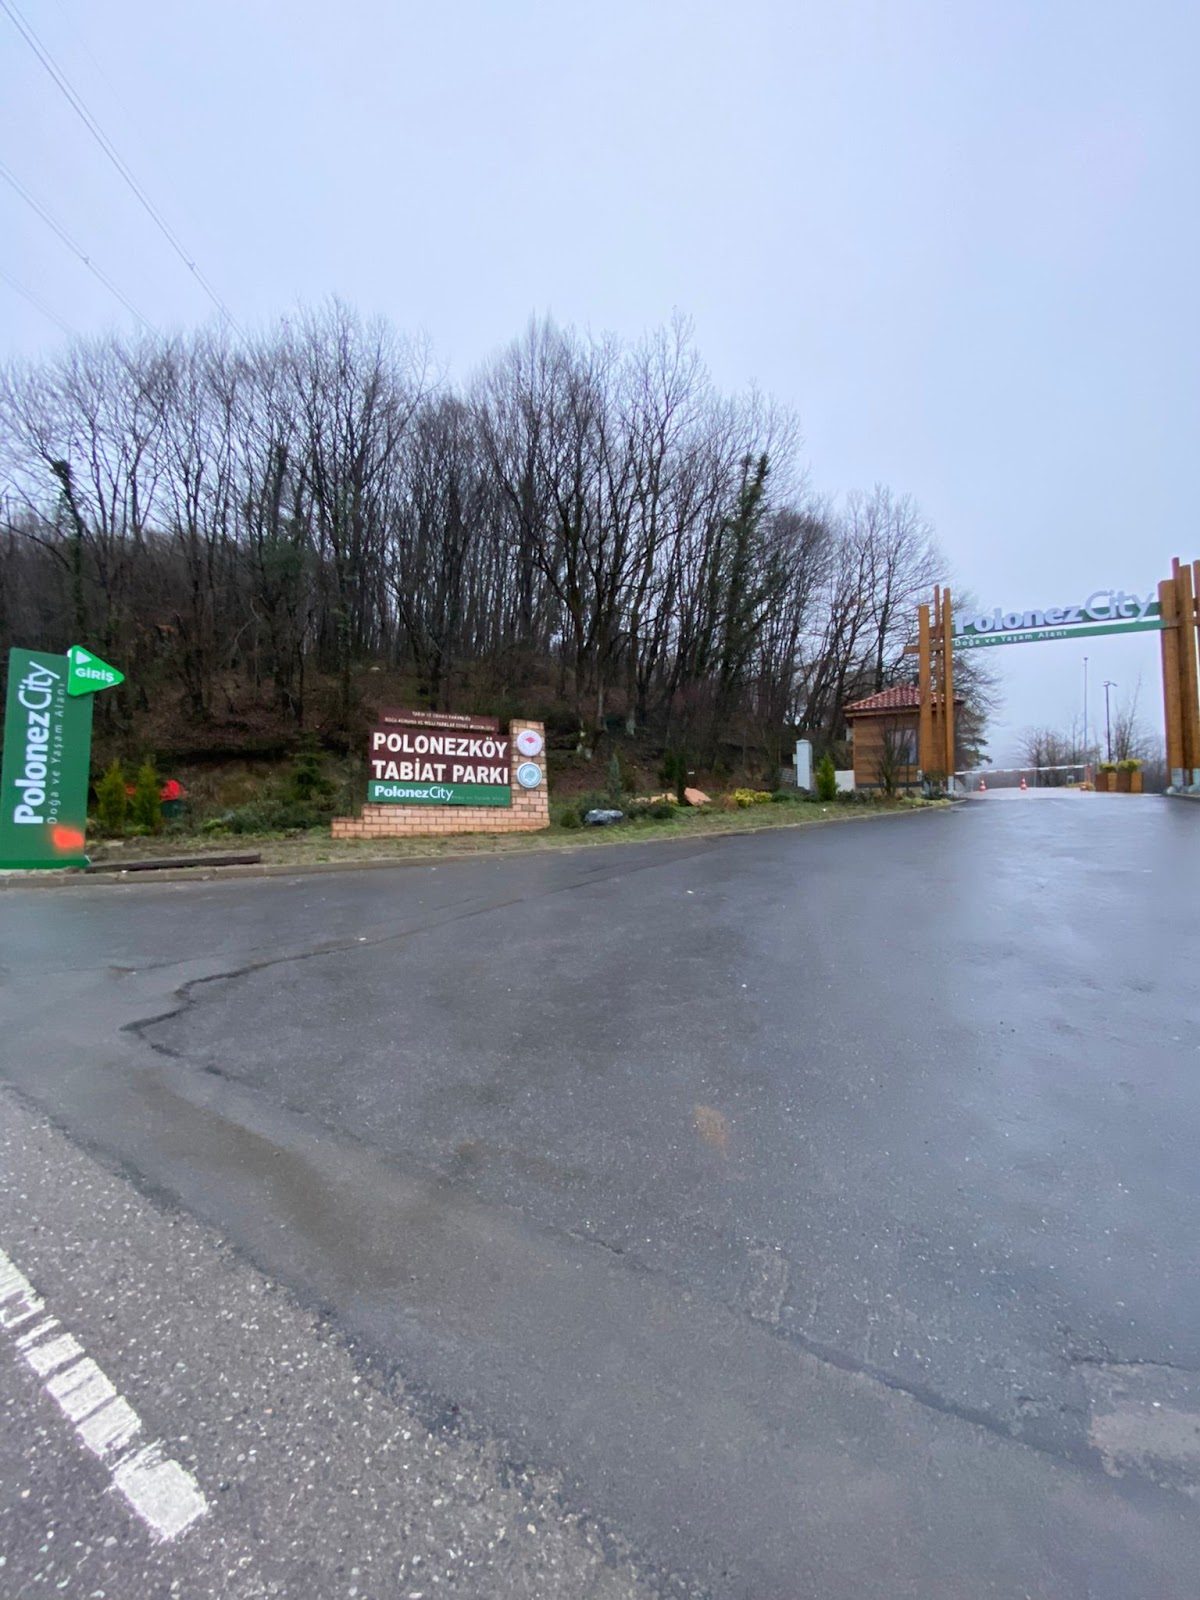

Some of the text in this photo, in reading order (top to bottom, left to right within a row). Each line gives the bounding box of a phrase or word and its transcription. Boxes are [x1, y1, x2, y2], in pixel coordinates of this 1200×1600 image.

[75, 667, 115, 683] GİRİŞ
[46, 682, 65, 825] Doğa ve Yaşam Alanı
[373, 732, 508, 759] POLONEZKÖY
[372, 758, 447, 782] TABİAT
[452, 765, 509, 785] PARKI
